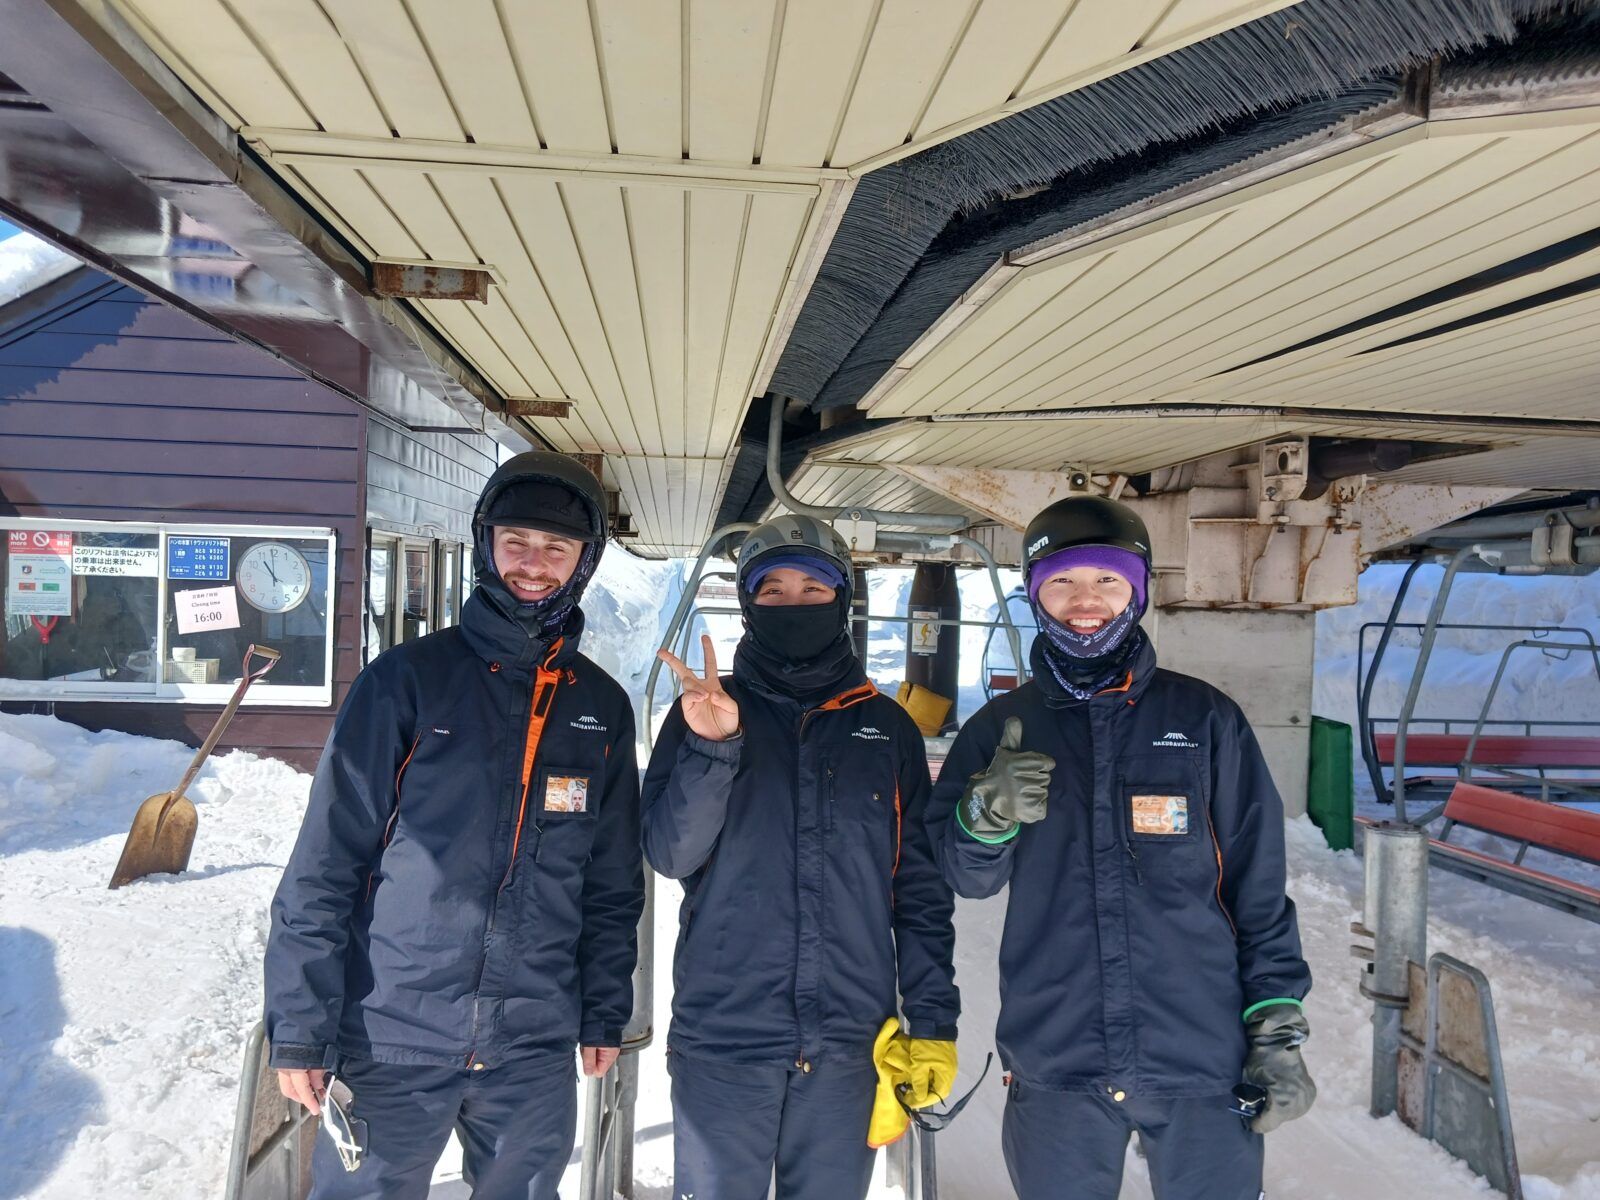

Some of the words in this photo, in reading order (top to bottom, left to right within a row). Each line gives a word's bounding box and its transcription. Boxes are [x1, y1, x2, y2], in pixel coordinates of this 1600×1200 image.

[10, 532, 27, 541] NO
[1028, 535, 1049, 557] bern
[74, 548, 158, 558] このリフトは法令により下り
[259, 552, 266, 560] 11
[249, 560, 258, 569] 10
[292, 561, 299, 570] 2
[74, 565, 126, 574] ご了承ください。
[249, 584, 256, 593] 8
[292, 585, 299, 593] 4
[259, 593, 265, 601] 7
[272, 596, 278, 605] 6
[284, 593, 291, 602] 5
[194, 611, 222, 623] 16:00
